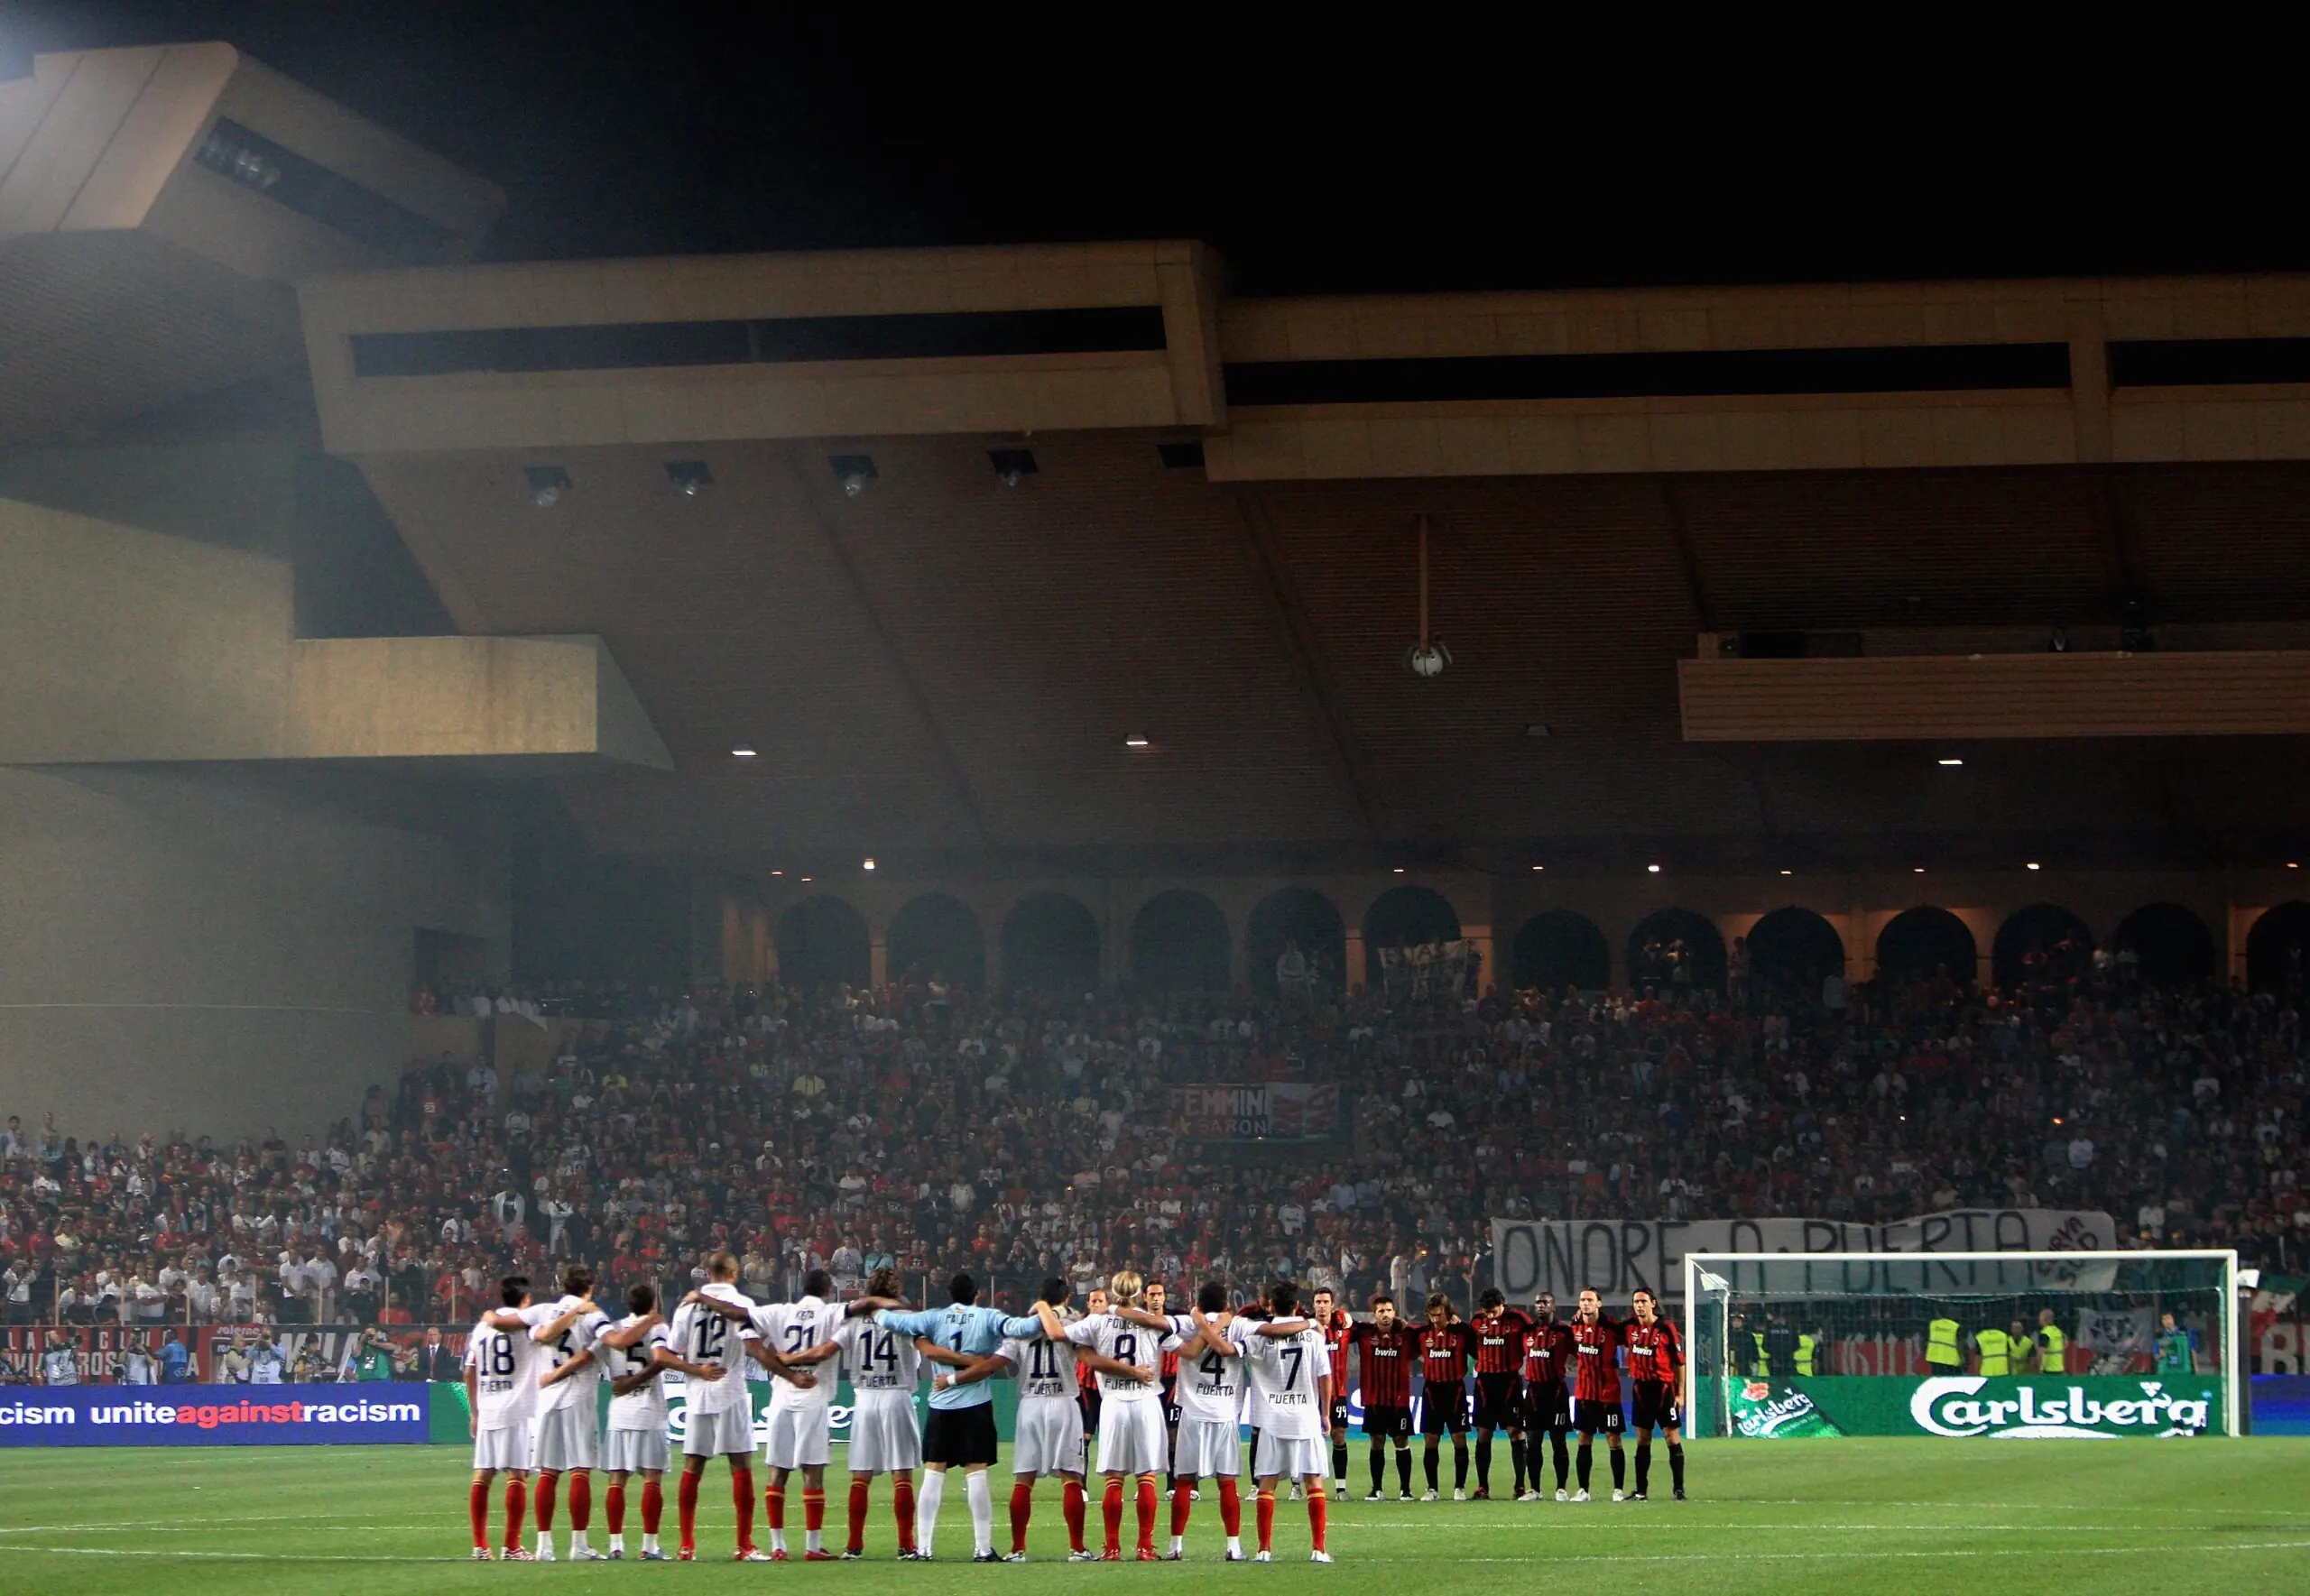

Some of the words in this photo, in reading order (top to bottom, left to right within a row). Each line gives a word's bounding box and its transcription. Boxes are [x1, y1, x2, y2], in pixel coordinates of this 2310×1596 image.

[1502, 1221, 1691, 1297] ONORE
[1804, 1211, 2033, 1293] PUERTA
[945, 1313, 975, 1325] PALOP
[695, 1314, 727, 1359] 12
[784, 1324, 818, 1364] 21
[1483, 1336, 1504, 1346] bwin
[478, 1334, 515, 1377] 18
[859, 1329, 899, 1372] 14
[1374, 1347, 1398, 1357] bwin
[1429, 1349, 1451, 1358] bwin
[1529, 1349, 1550, 1359] bwin
[1578, 1343, 1599, 1355] bwin
[1631, 1343, 1653, 1356] bwin
[1029, 1339, 1059, 1379] 11
[1199, 1345, 1225, 1386] 4
[1280, 1347, 1303, 1391] 7
[859, 1374, 899, 1388] PUERTA
[1029, 1381, 1064, 1395] PUERTA
[1196, 1382, 1234, 1398] PUERTA
[1268, 1393, 1307, 1406] PUERTA
[1910, 1377, 2209, 1437] Carlsberg
[1669, 1407, 1677, 1421] 9
[1735, 1392, 1814, 1436] Carlsberg
